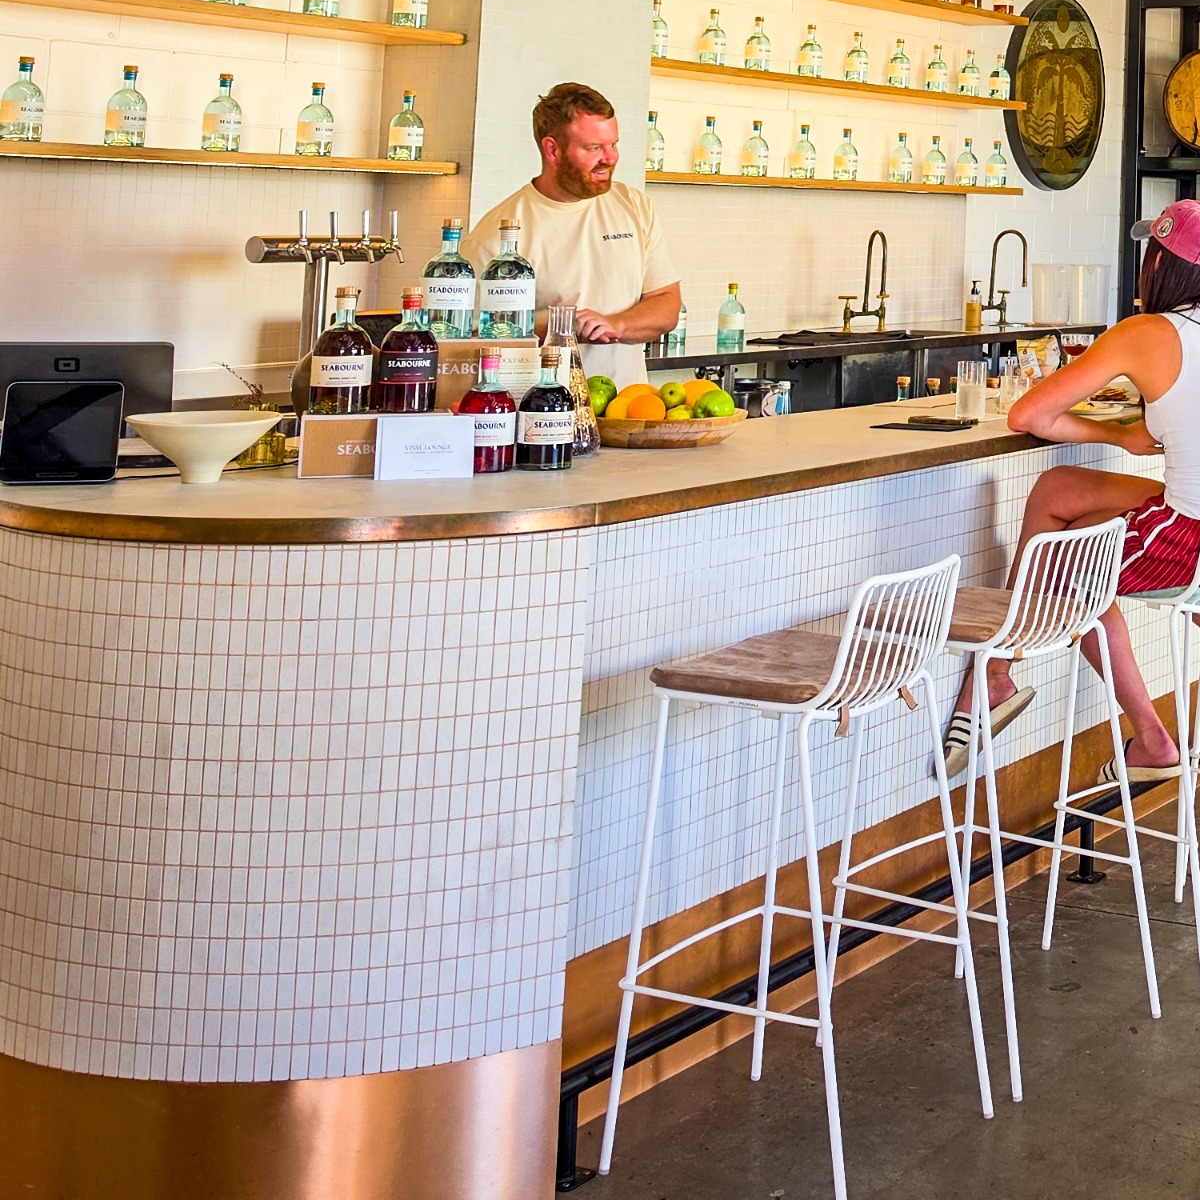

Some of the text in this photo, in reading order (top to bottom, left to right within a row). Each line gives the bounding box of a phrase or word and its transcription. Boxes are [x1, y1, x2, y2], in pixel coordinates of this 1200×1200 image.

[429, 286, 470, 295] SEABOURNE
[487, 288, 528, 296] SEABOURNE
[321, 363, 365, 372] SEABOURNE
[387, 359, 431, 368] SEABOURNE
